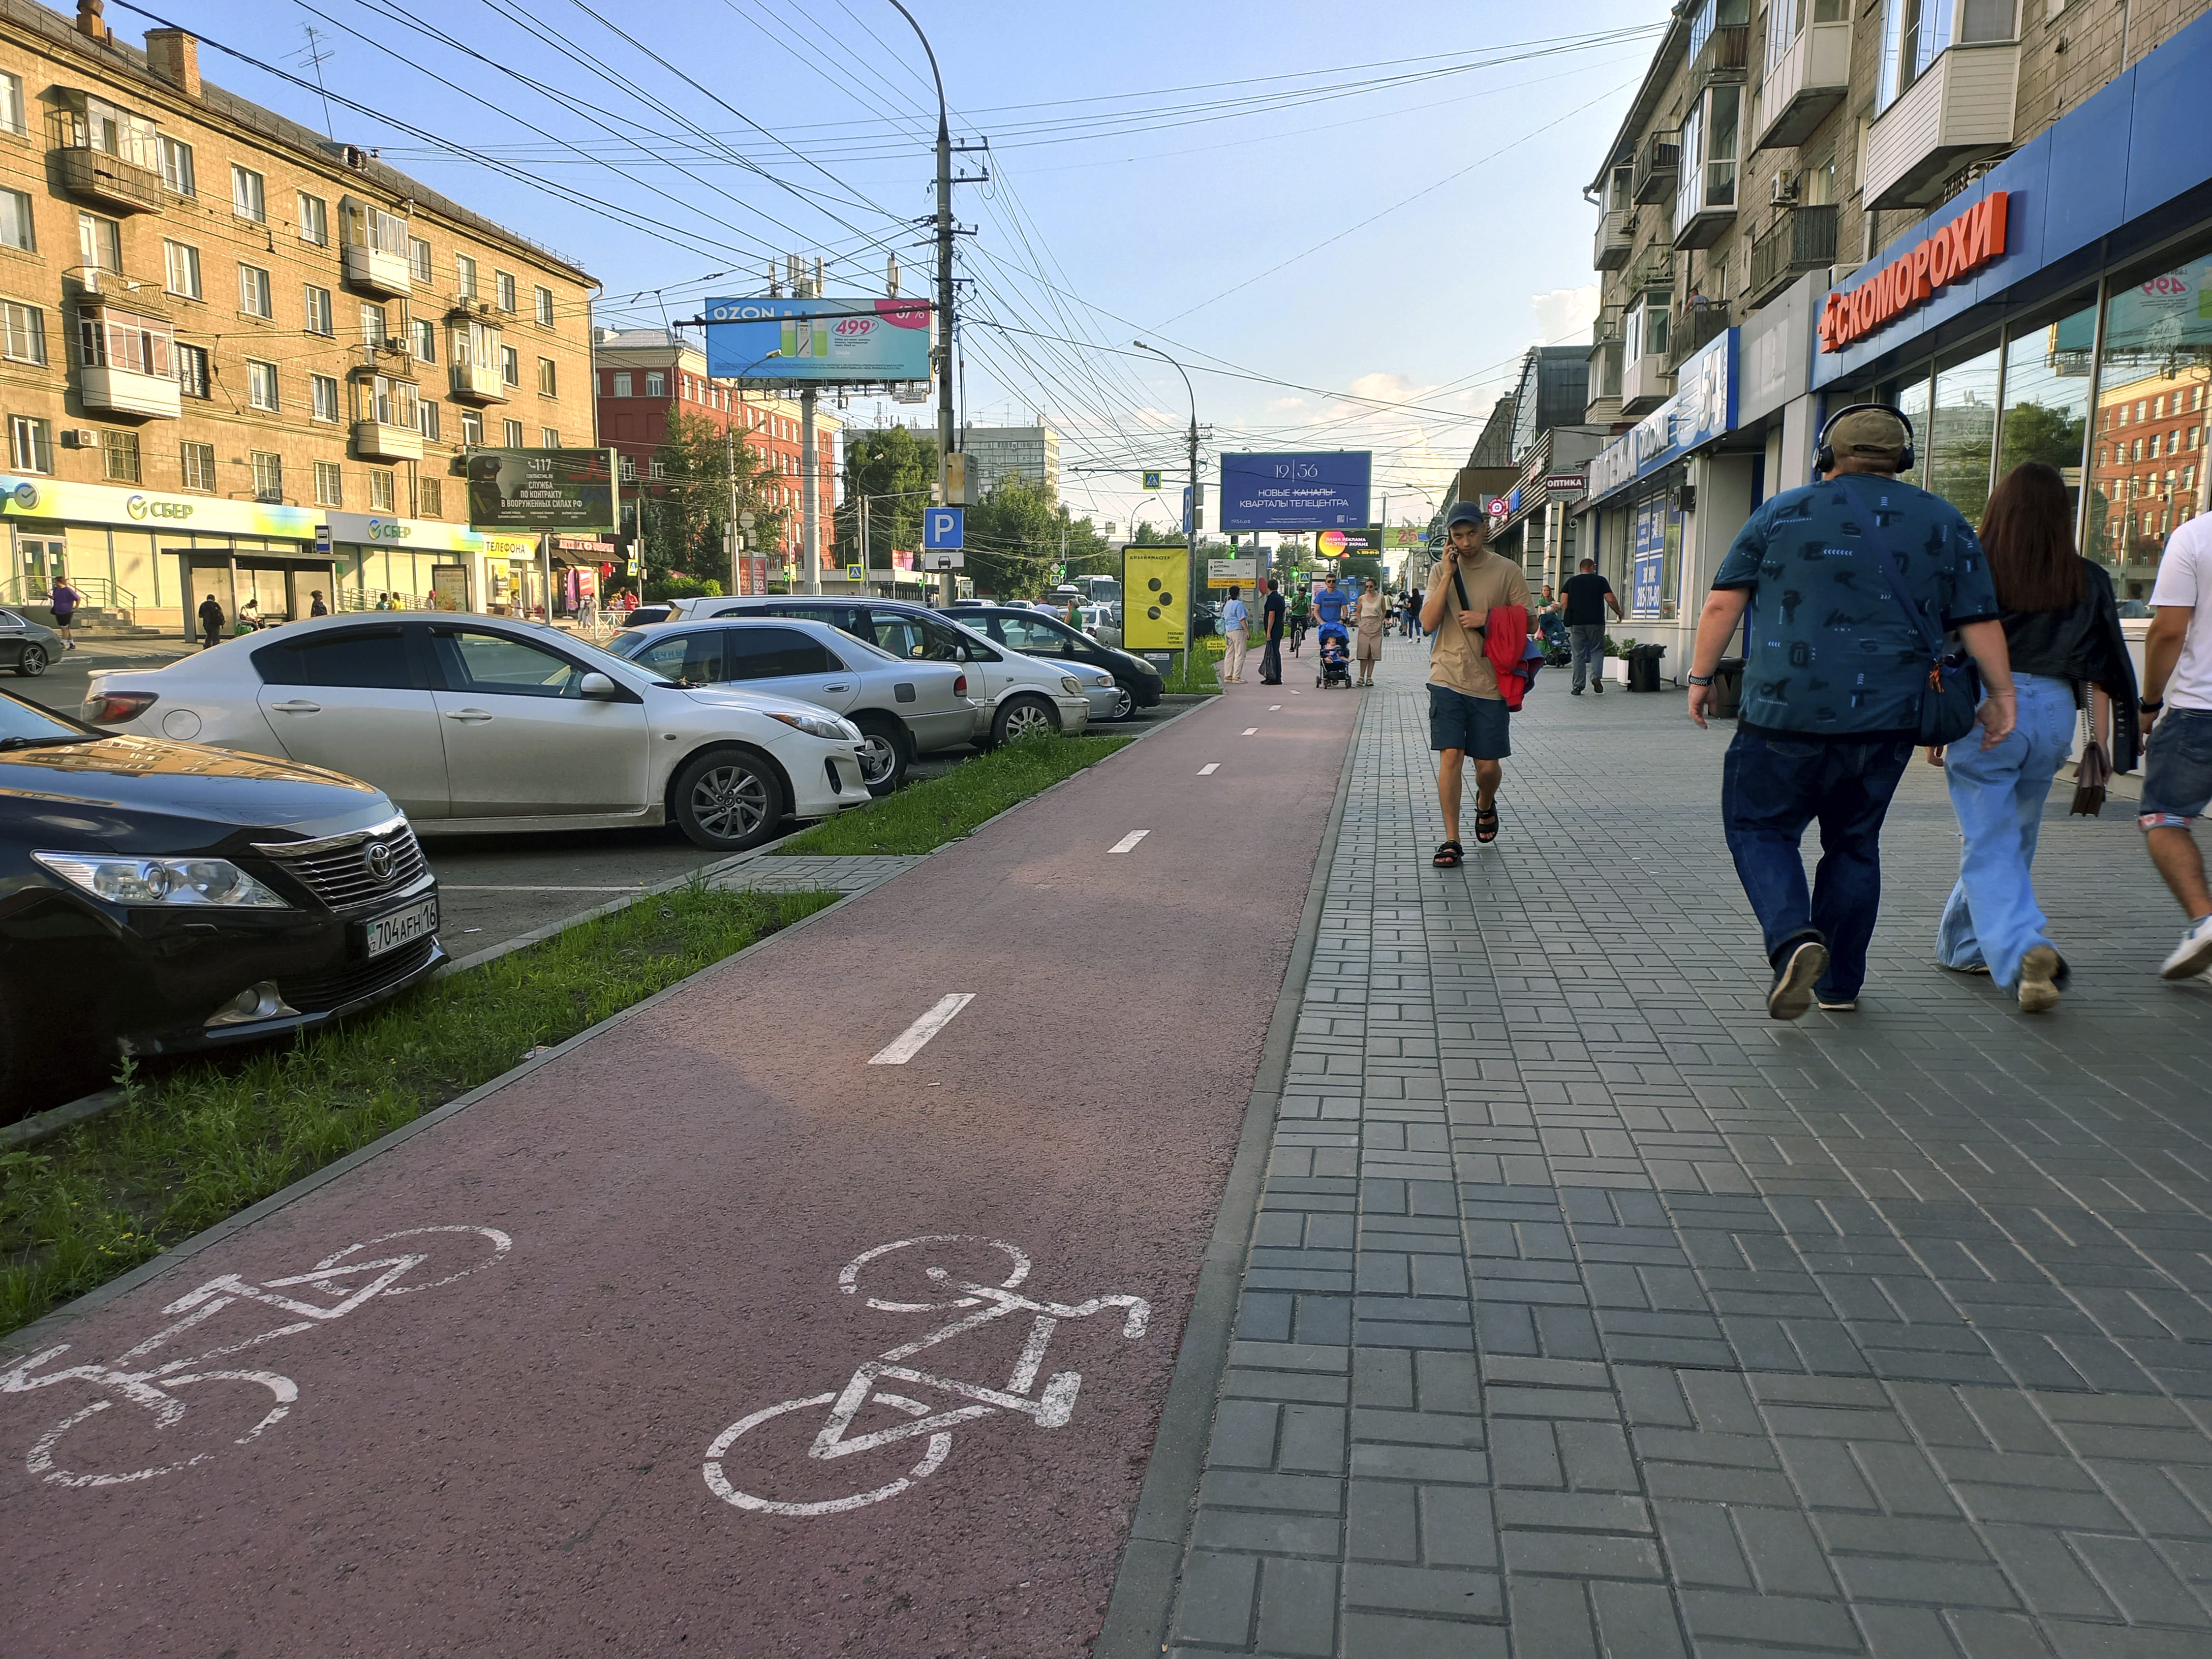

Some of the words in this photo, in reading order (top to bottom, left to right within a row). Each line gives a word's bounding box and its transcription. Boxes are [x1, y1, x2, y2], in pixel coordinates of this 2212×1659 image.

[1837, 191, 2007, 345] СКОМОРОХИ
[713, 307, 774, 320] OZON
[535, 459, 551, 471] 117
[1547, 479, 1582, 487] ОПТИКА
[507, 499, 551, 508] ВООРУЖЕННЫХ
[553, 499, 572, 508] СИЛАХ
[1240, 499, 1288, 508] КВАРТАЛЫ
[1290, 499, 1349, 508] ТЕЛЕЦЕНТРА
[151, 502, 193, 519] СБЕР
[384, 524, 411, 538] СБЕР
[935, 514, 954, 542] P
[486, 542, 525, 553] ТЕЛЕФОНА
[423, 901, 436, 928] 16
